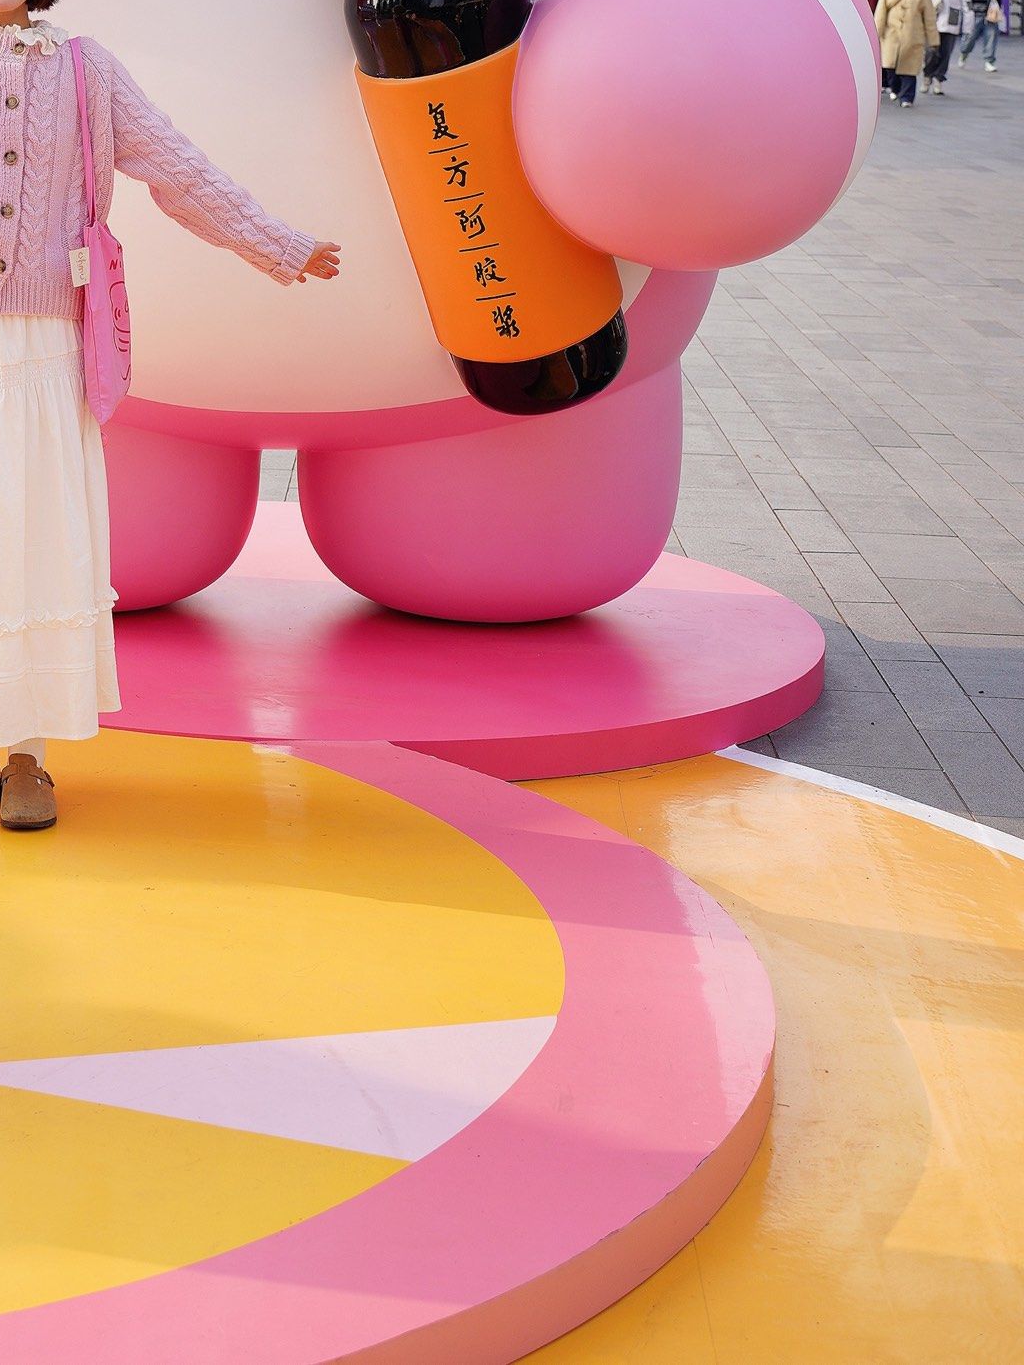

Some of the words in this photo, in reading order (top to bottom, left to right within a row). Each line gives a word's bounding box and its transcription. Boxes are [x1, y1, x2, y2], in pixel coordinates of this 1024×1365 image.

[428, 102, 521, 339] 复方阿胶浆
